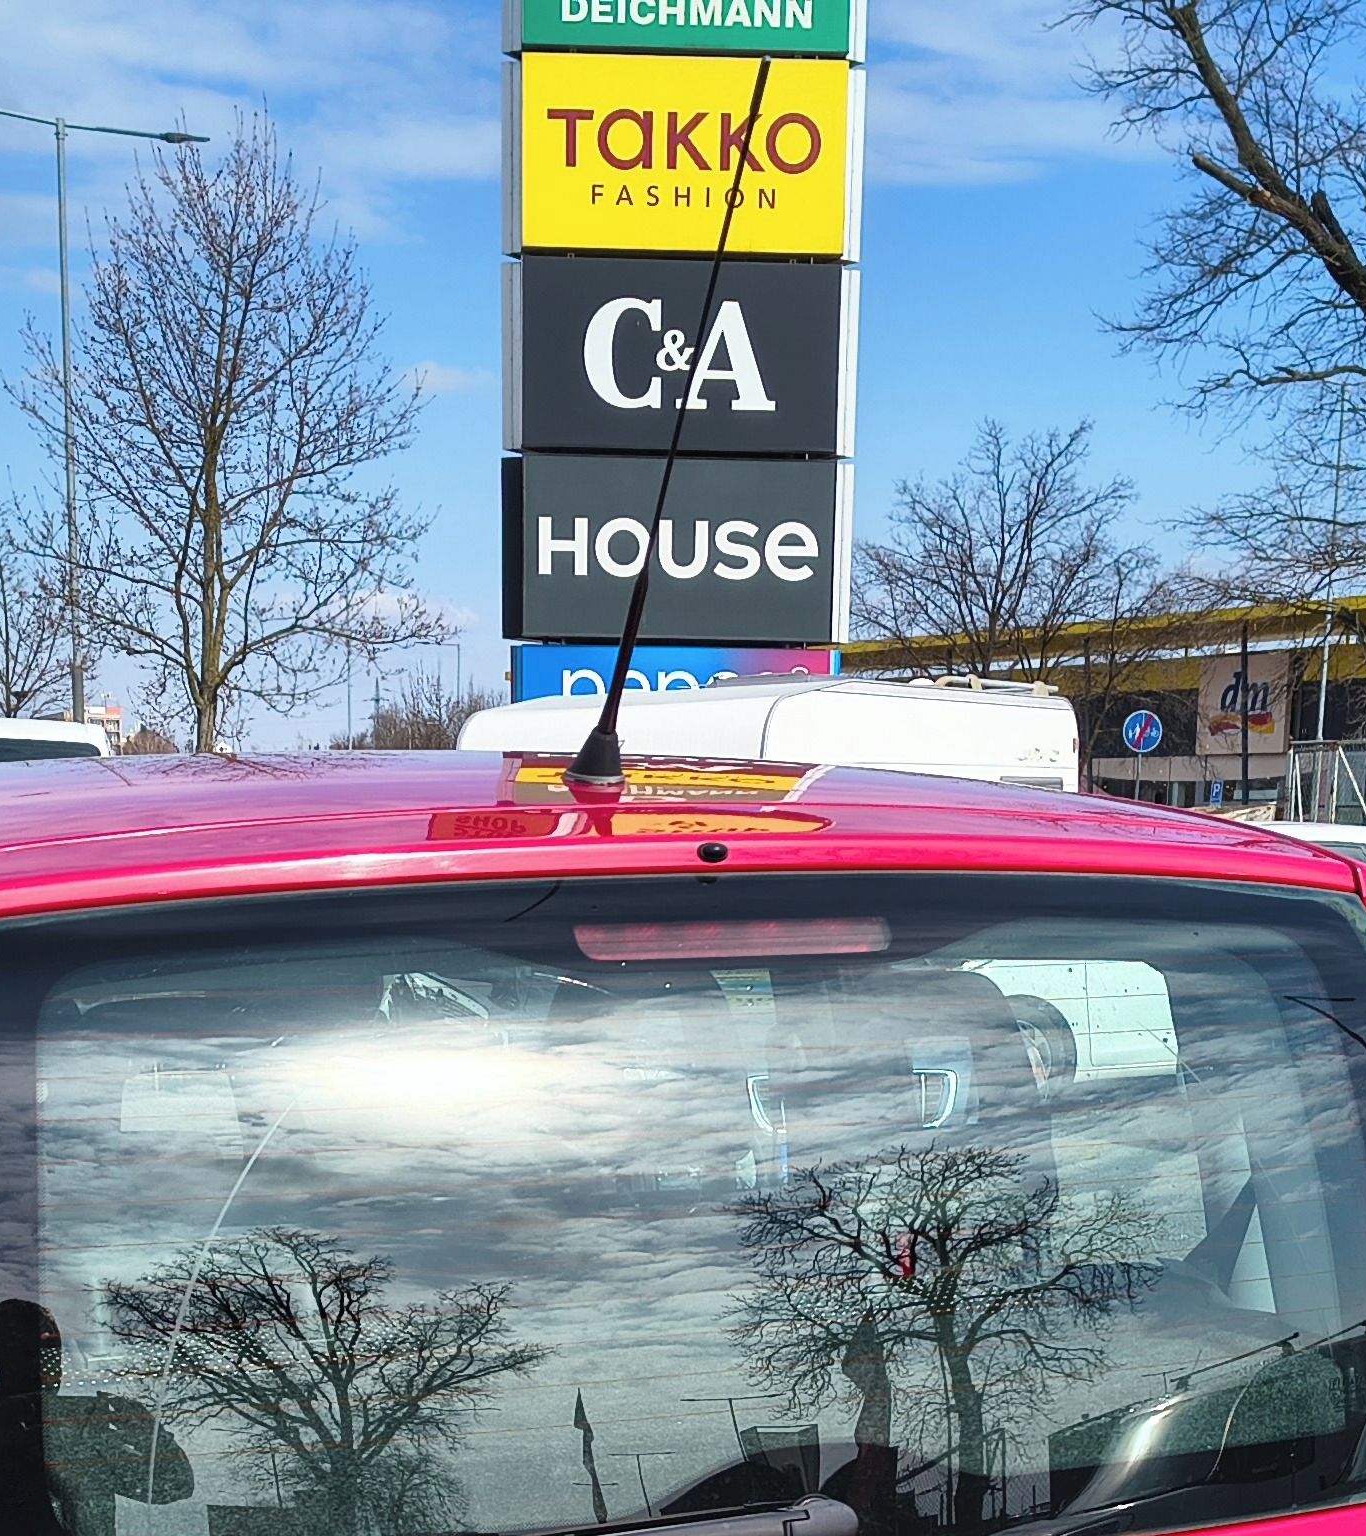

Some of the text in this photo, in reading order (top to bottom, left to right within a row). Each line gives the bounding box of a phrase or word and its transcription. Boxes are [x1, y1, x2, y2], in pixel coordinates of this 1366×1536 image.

[561, 0, 813, 29] DEICHMANN
[591, 184, 777, 209] FASHION
[583, 297, 776, 412] C&A
